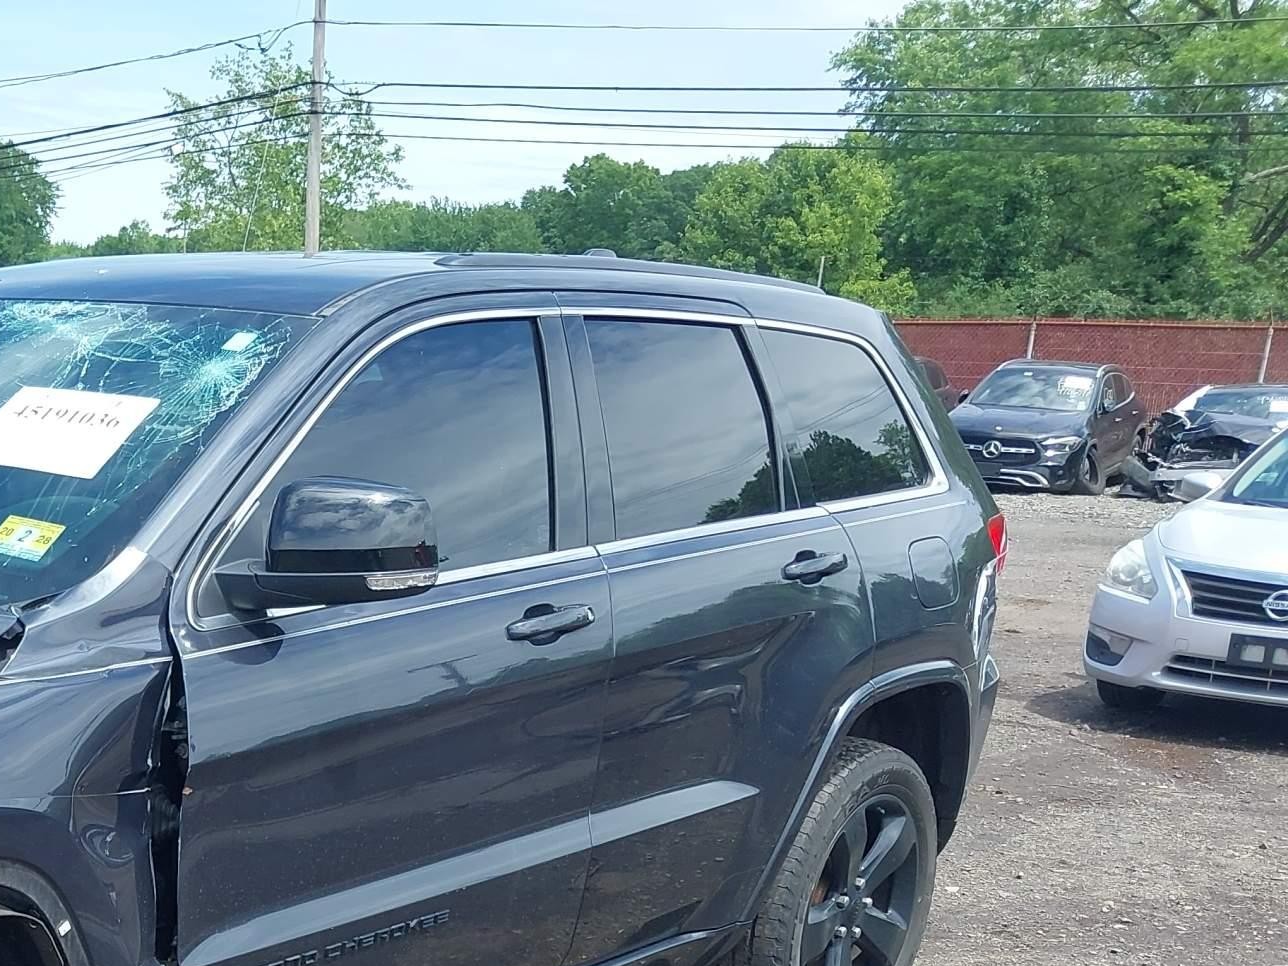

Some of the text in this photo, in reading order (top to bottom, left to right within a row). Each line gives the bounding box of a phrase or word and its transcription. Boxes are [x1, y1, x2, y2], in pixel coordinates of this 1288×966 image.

[13, 405, 120, 428] 45191036
[0, 526, 52, 545] 20 2 28
[325, 908, 451, 959] CHEROKEE
